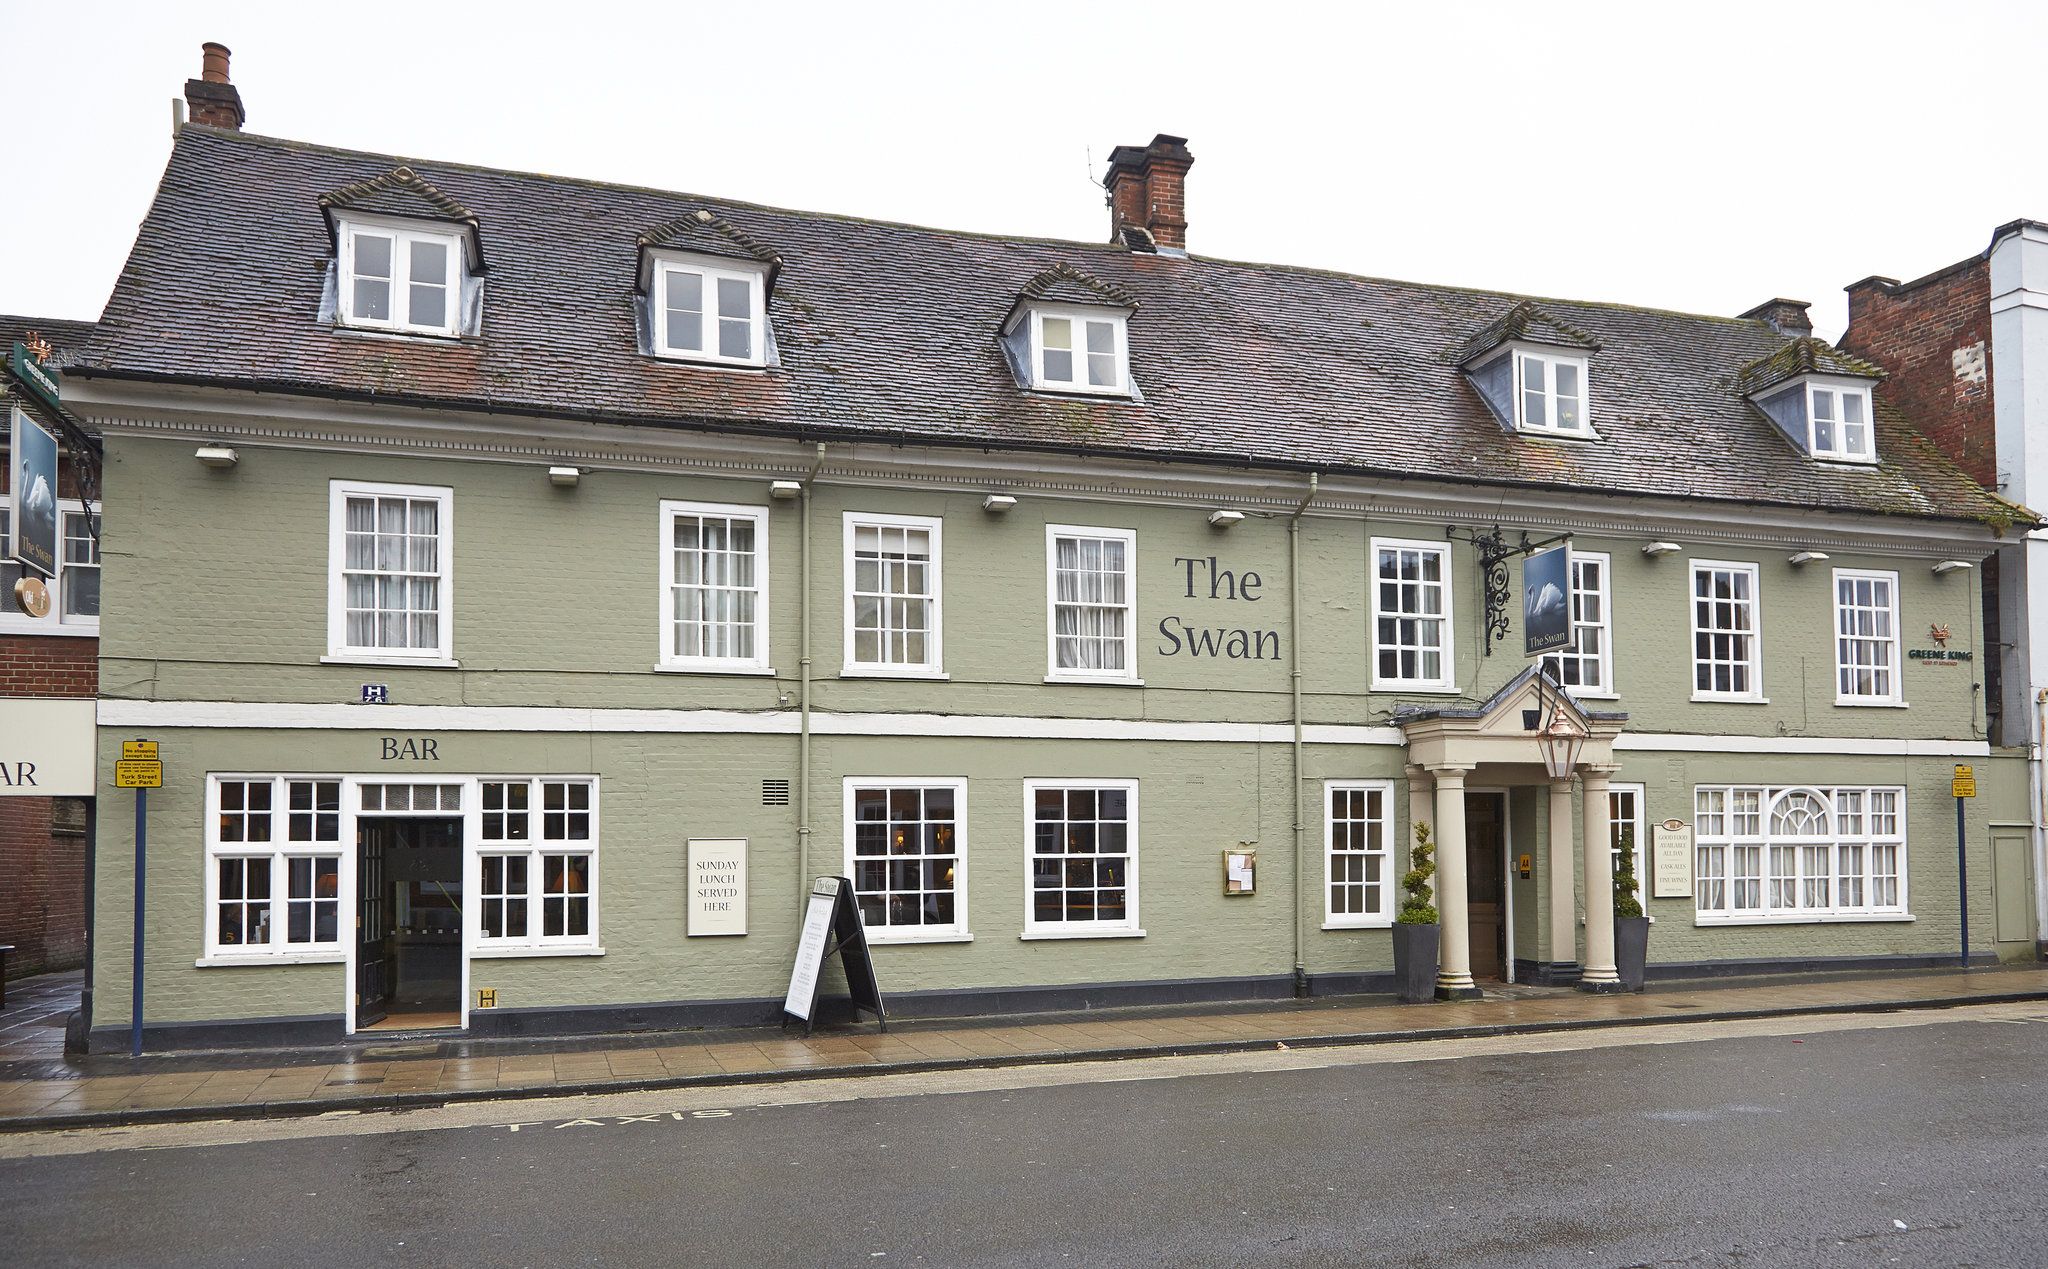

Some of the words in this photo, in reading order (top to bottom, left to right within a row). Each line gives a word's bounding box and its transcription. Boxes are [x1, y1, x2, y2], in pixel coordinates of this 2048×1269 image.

[22, 536, 35, 555] The
[35, 544, 53, 566] Swan
[1174, 556, 1262, 602] The
[1158, 616, 1282, 661] Swan
[1529, 636, 1544, 648] The
[1544, 632, 1565, 645] Swan
[1908, 650, 1946, 660] GREENE
[1947, 651, 1973, 661] KING
[367, 686, 381, 696] H
[380, 736, 440, 760] BAR
[696, 861, 739, 870] SUNDAY
[700, 875, 735, 884] LUNCH
[697, 888, 738, 898] SERVED
[704, 902, 732, 912] HERE
[490, 1109, 733, 1132] TAXIS
